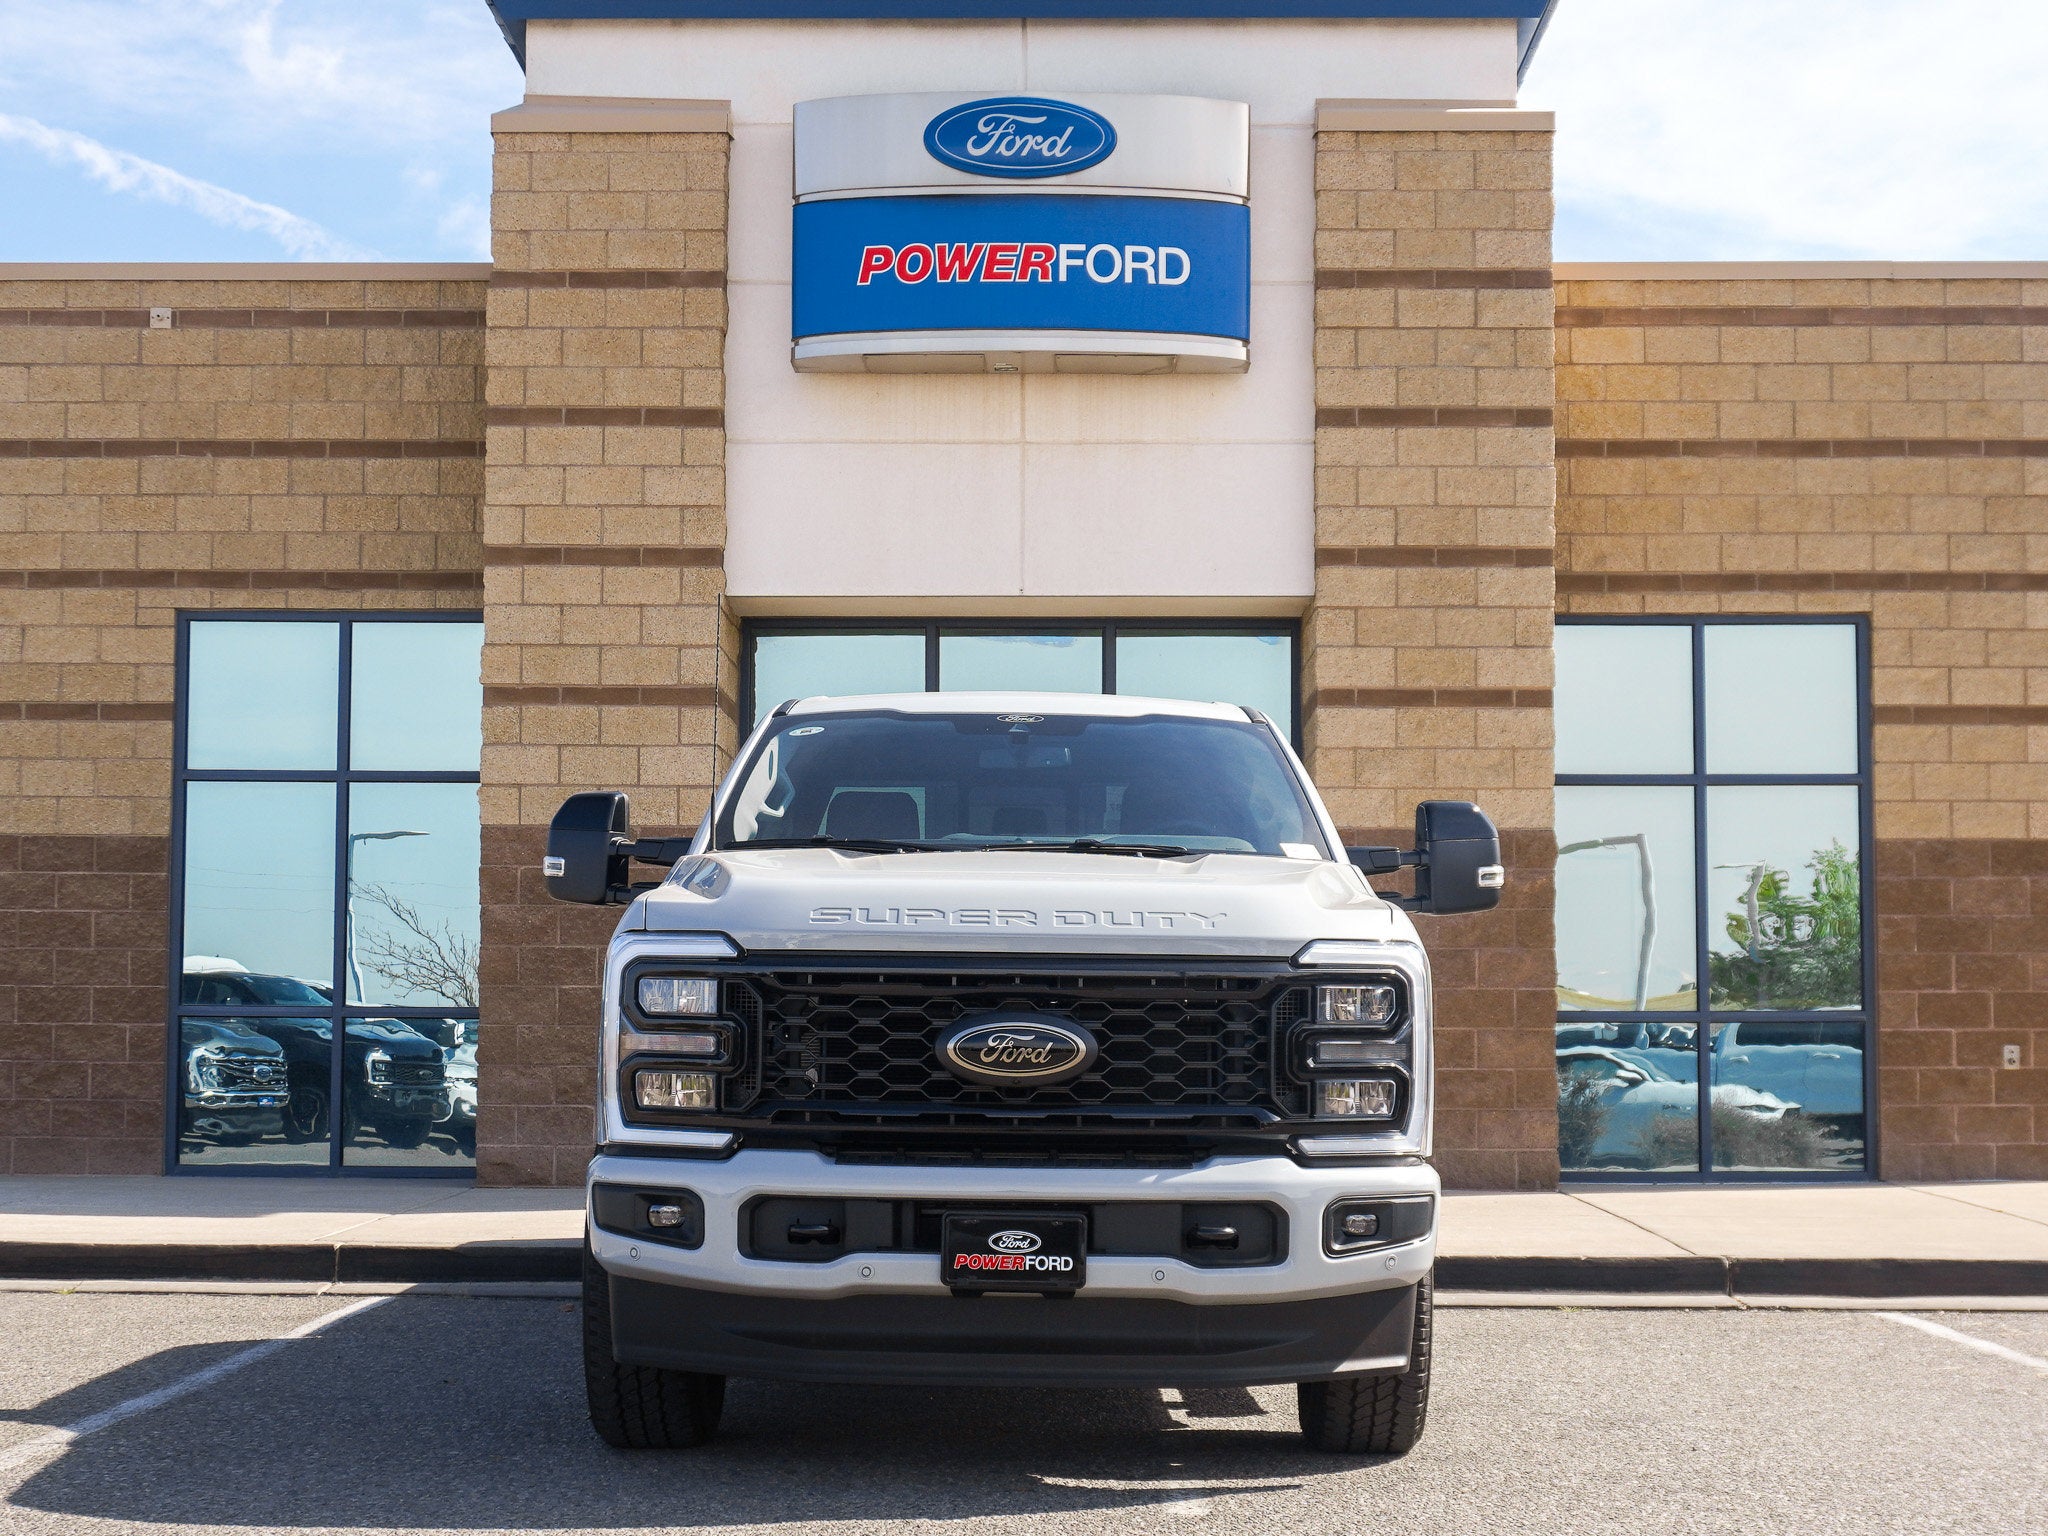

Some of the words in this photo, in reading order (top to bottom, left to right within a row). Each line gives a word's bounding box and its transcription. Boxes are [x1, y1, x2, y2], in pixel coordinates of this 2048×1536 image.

[966, 113, 1073, 158] Ford
[808, 906, 1038, 928] SUPER
[1052, 909, 1228, 930] DUTY
[979, 1033, 1053, 1064] Ford
[998, 1234, 1032, 1250] Ford
